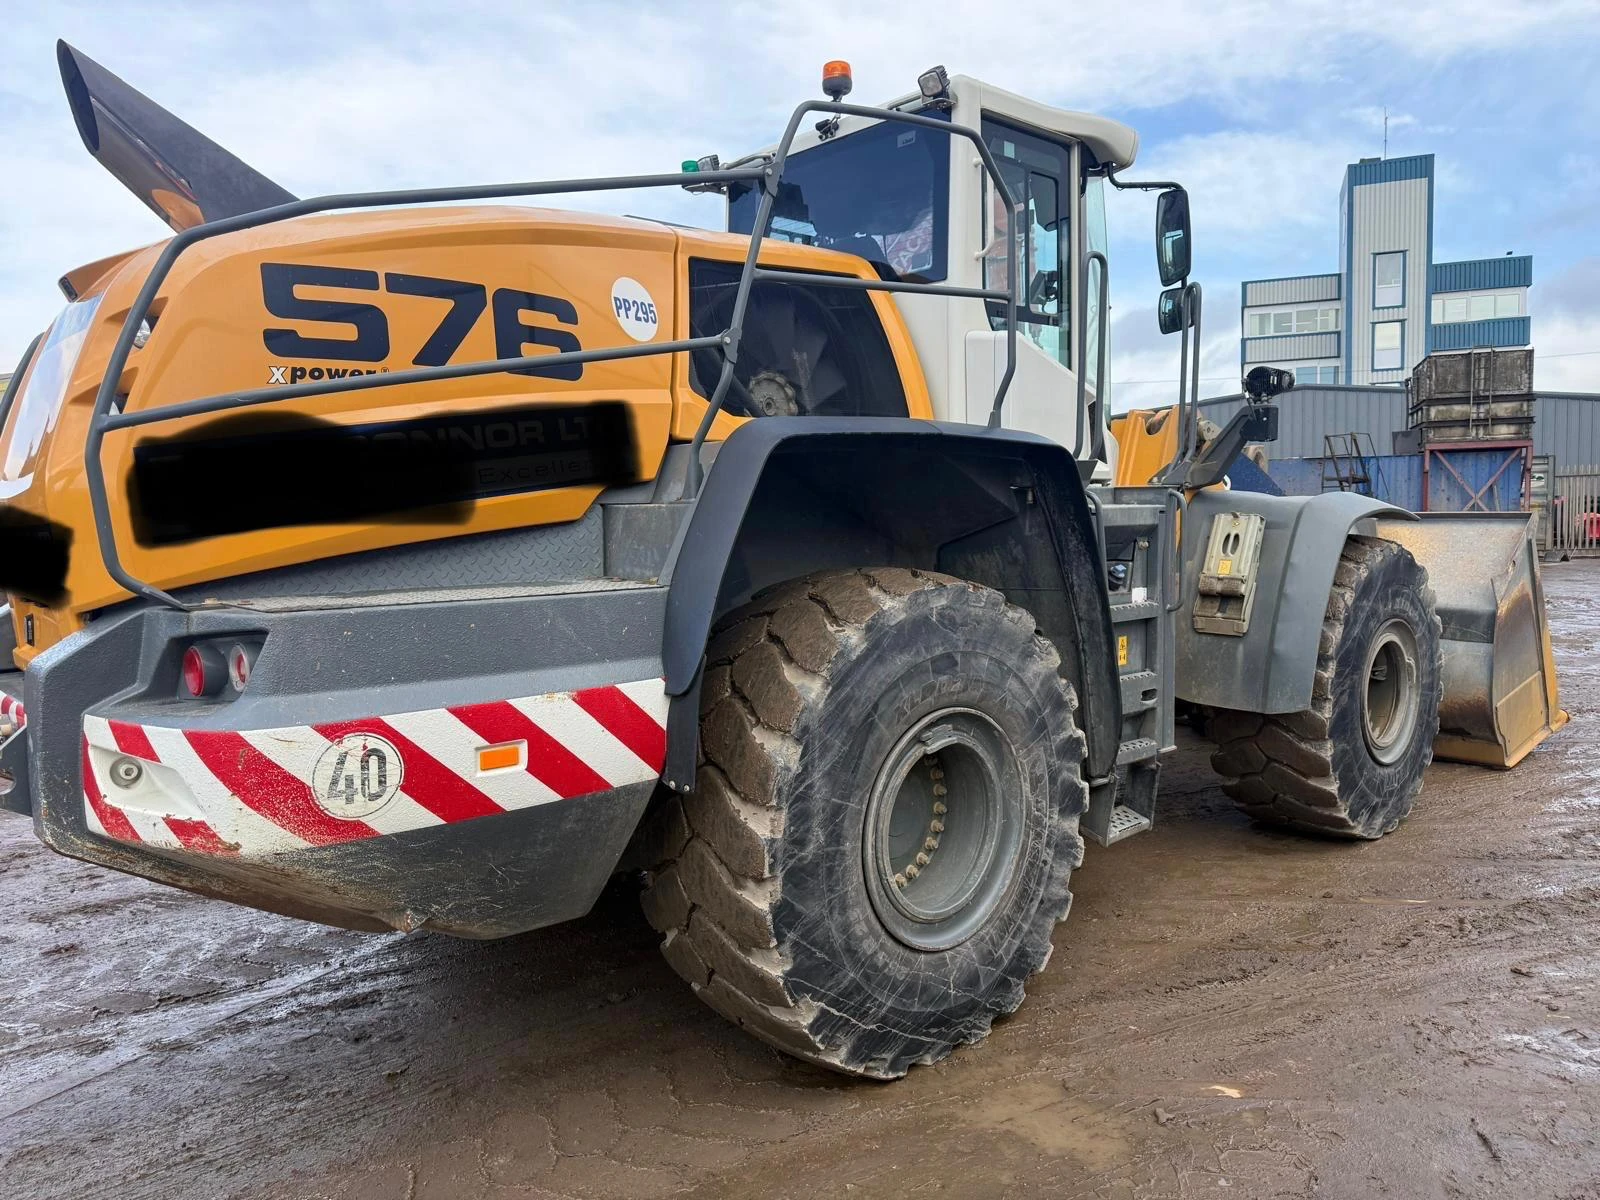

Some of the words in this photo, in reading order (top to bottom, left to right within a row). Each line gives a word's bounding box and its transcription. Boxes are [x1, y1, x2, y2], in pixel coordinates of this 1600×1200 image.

[260, 262, 584, 381] 576
[613, 296, 657, 325] PP295
[327, 747, 387, 805] 40
